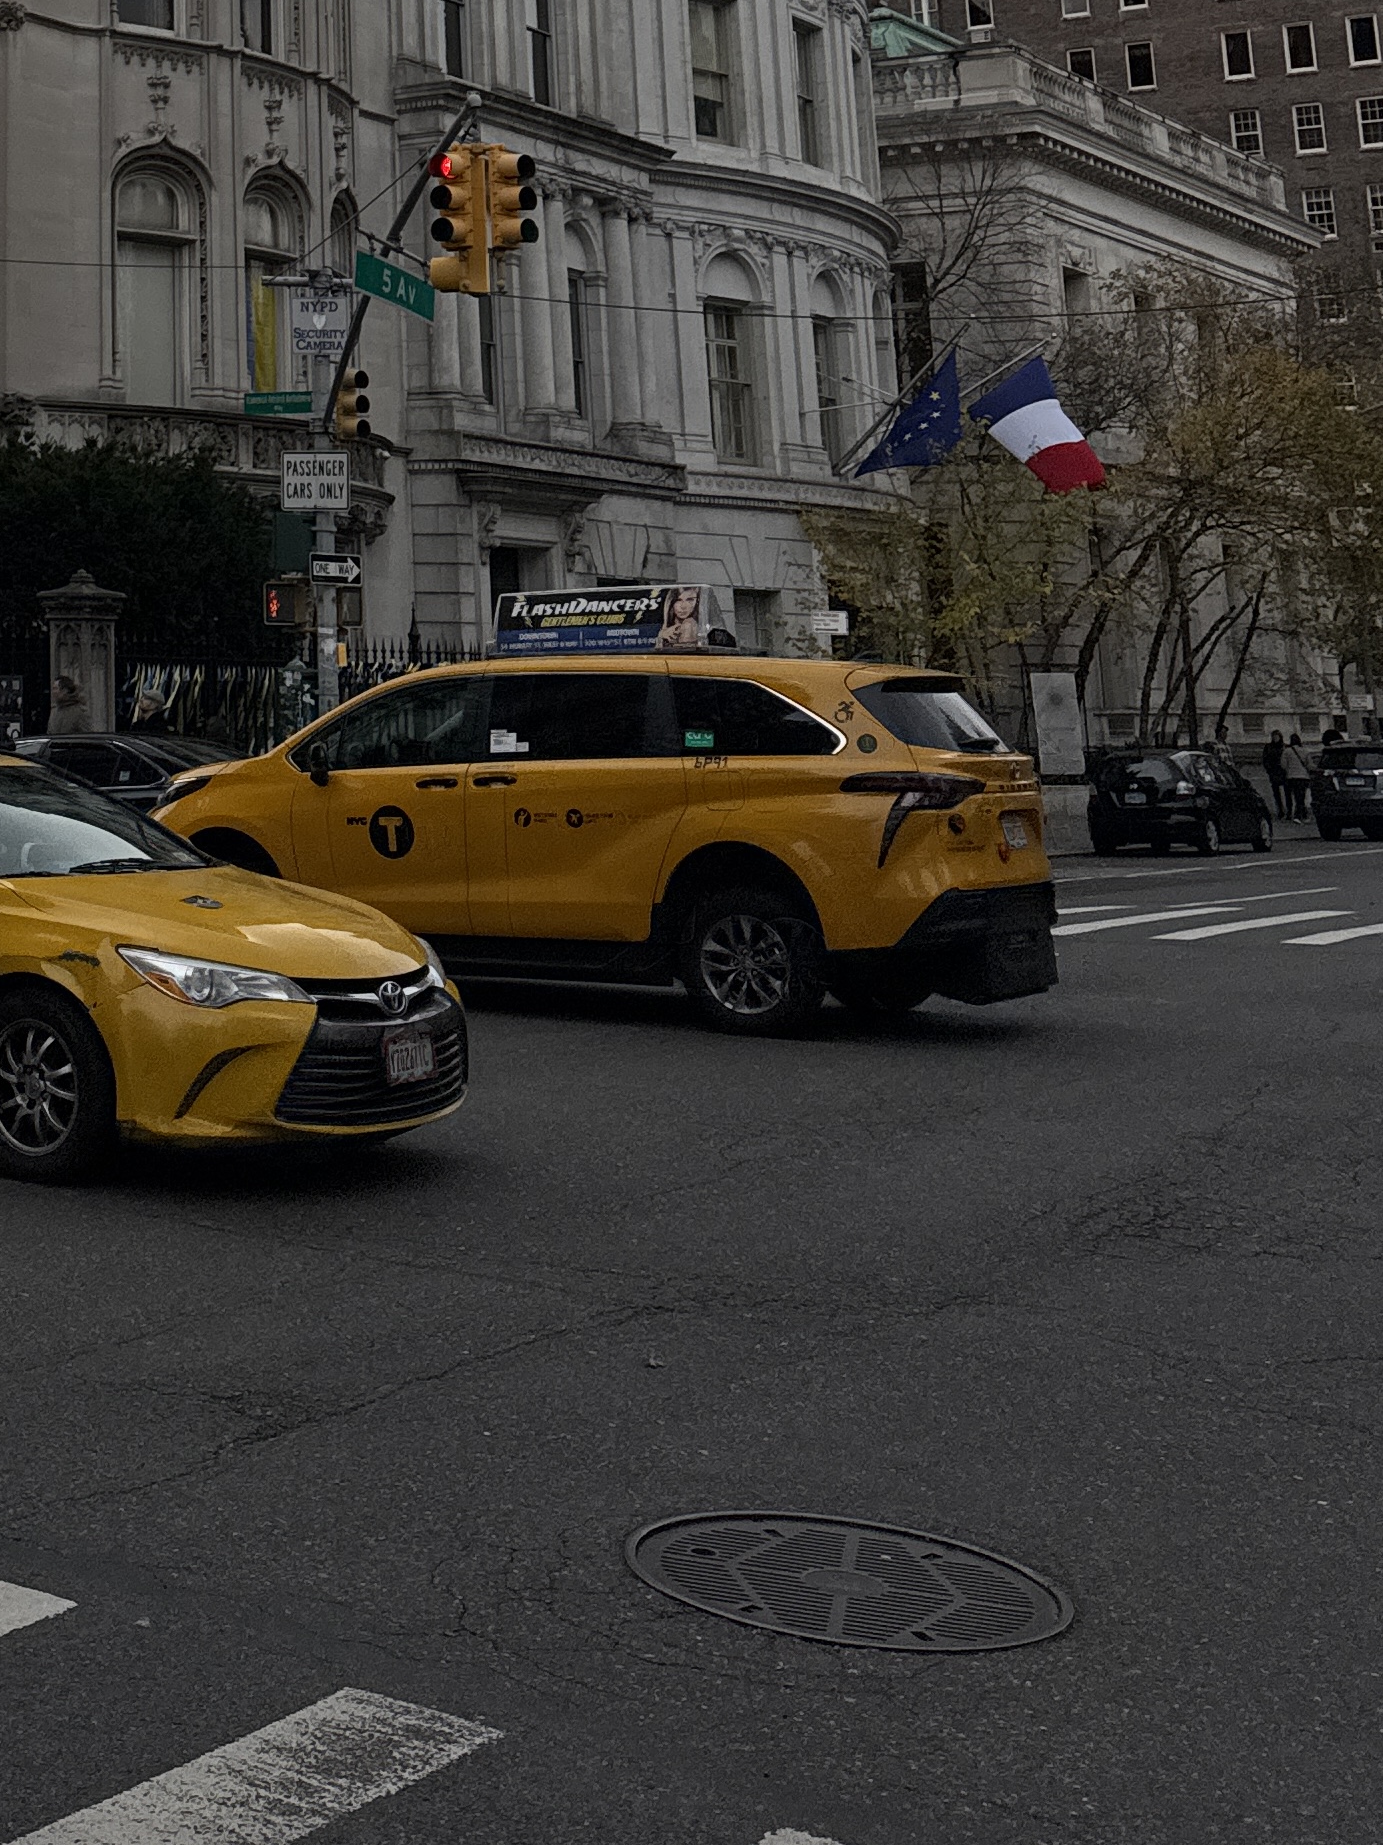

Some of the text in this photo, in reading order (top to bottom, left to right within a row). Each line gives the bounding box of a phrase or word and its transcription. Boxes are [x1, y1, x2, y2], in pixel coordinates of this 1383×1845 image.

[382, 268, 392, 293] 5
[300, 301, 339, 313] NYPD
[293, 327, 346, 339] SECURITY
[295, 339, 344, 351] CAMERA
[286, 460, 345, 477] PASSENGER
[286, 482, 345, 499] CARS ONLY
[315, 563, 355, 576] ONE WAY
[694, 756, 728, 769] 6P91
[346, 816, 368, 826] NYC
[378, 816, 403, 852] T
